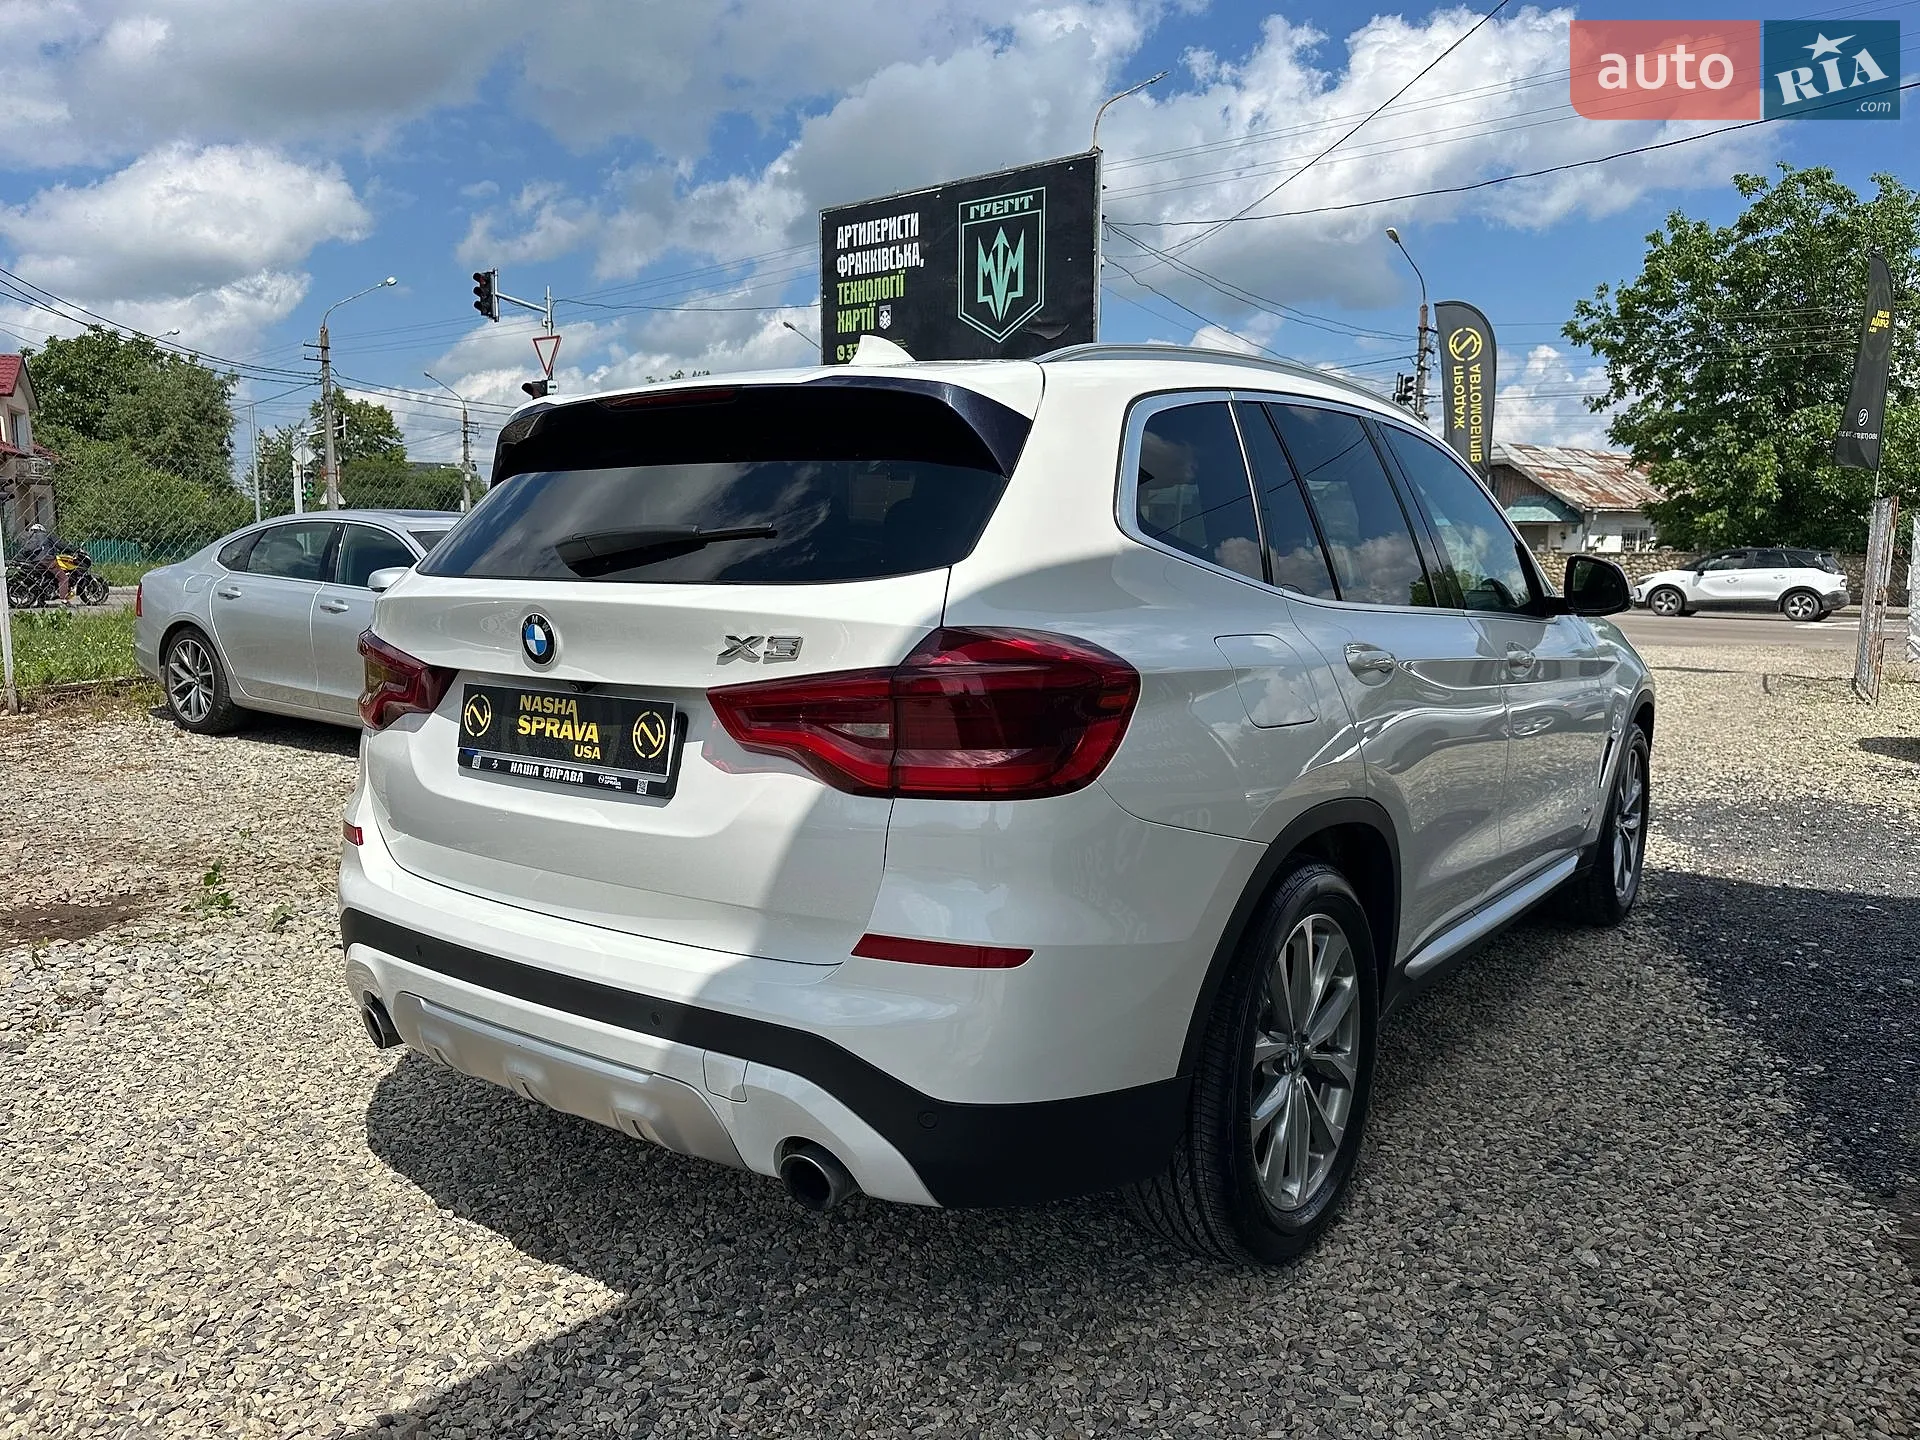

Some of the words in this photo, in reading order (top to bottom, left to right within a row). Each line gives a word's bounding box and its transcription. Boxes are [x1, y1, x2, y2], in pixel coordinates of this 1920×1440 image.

[836, 212, 919, 250] АРТИЛЕРИСТИ
[836, 242, 925, 277] ФРАНКІВСЬКА,
[836, 269, 906, 306] ТЕХНОЛОГІЇ
[836, 303, 876, 333] ХАРТІЇ
[716, 635, 803, 665] X3
[519, 694, 577, 717] NASHA
[517, 714, 599, 743] SPRAVA
[574, 744, 601, 760] USA
[510, 761, 540, 777] НАША
[543, 767, 584, 783] СПРАВА
